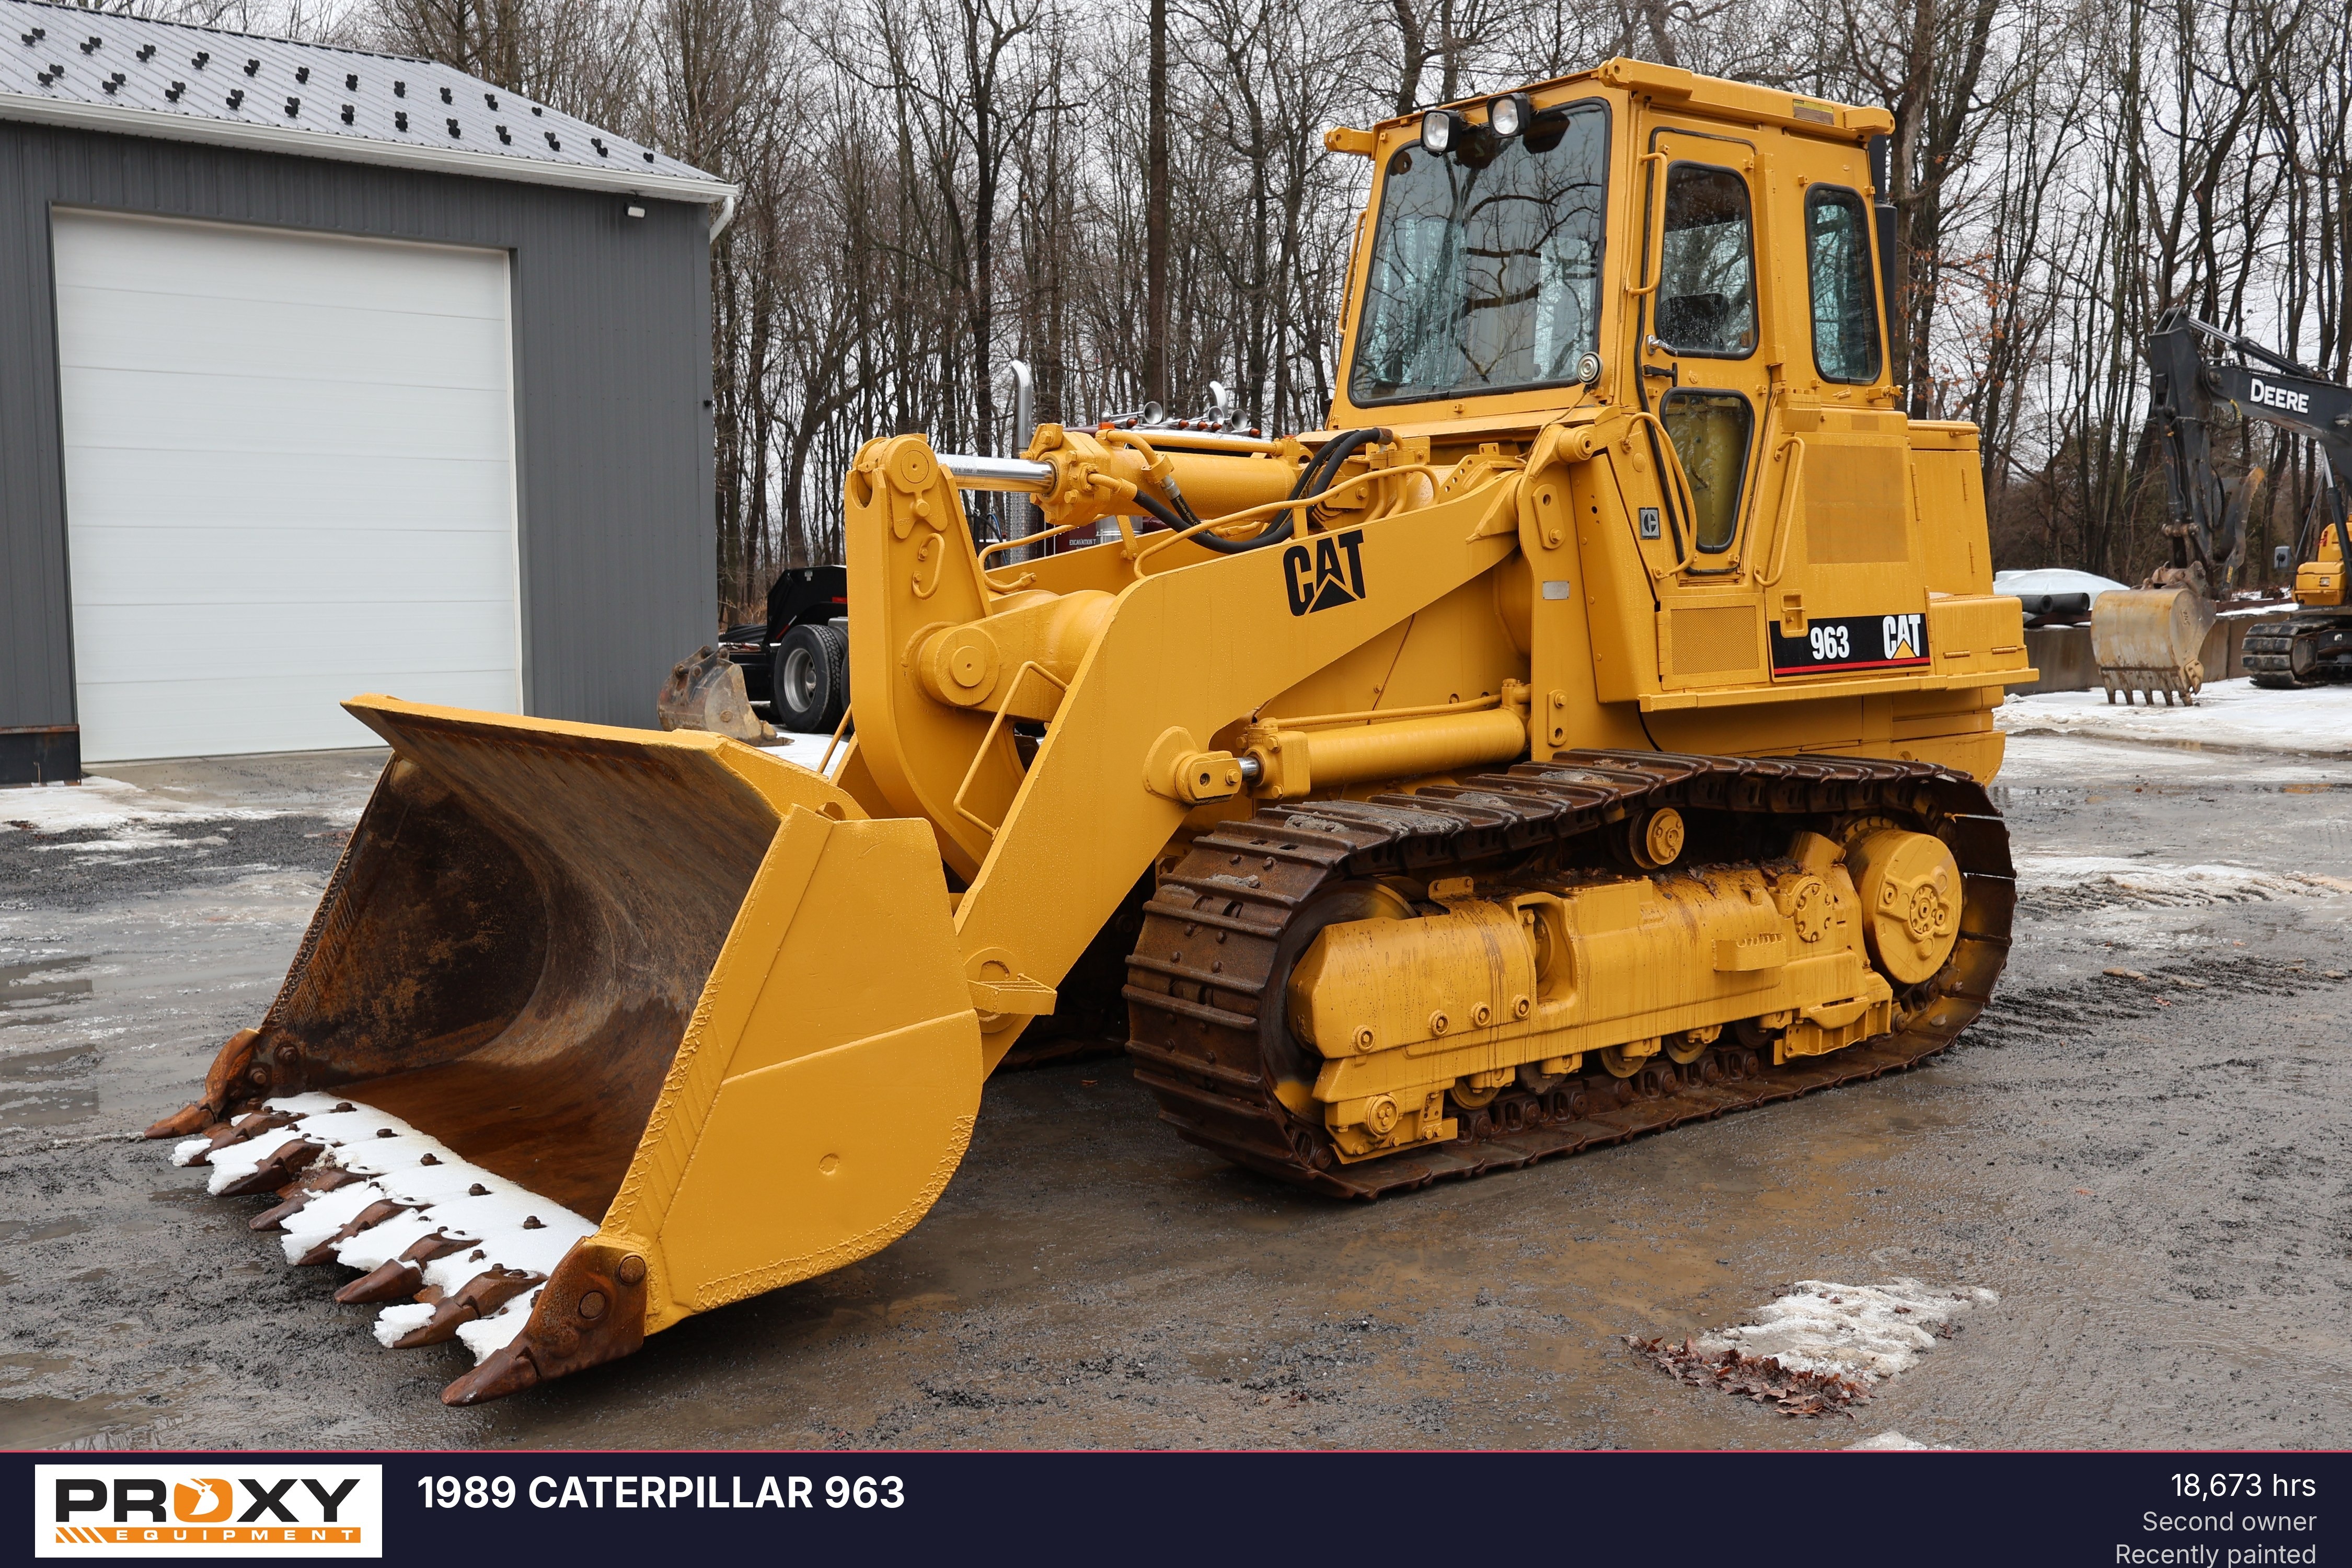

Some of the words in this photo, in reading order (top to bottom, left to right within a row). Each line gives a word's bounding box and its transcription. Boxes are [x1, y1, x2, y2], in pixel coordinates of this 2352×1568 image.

[2251, 378, 2309, 413] DEERE
[1284, 530, 1366, 616] CAT
[1811, 626, 1849, 660] 963
[1883, 614, 1921, 660] CAT
